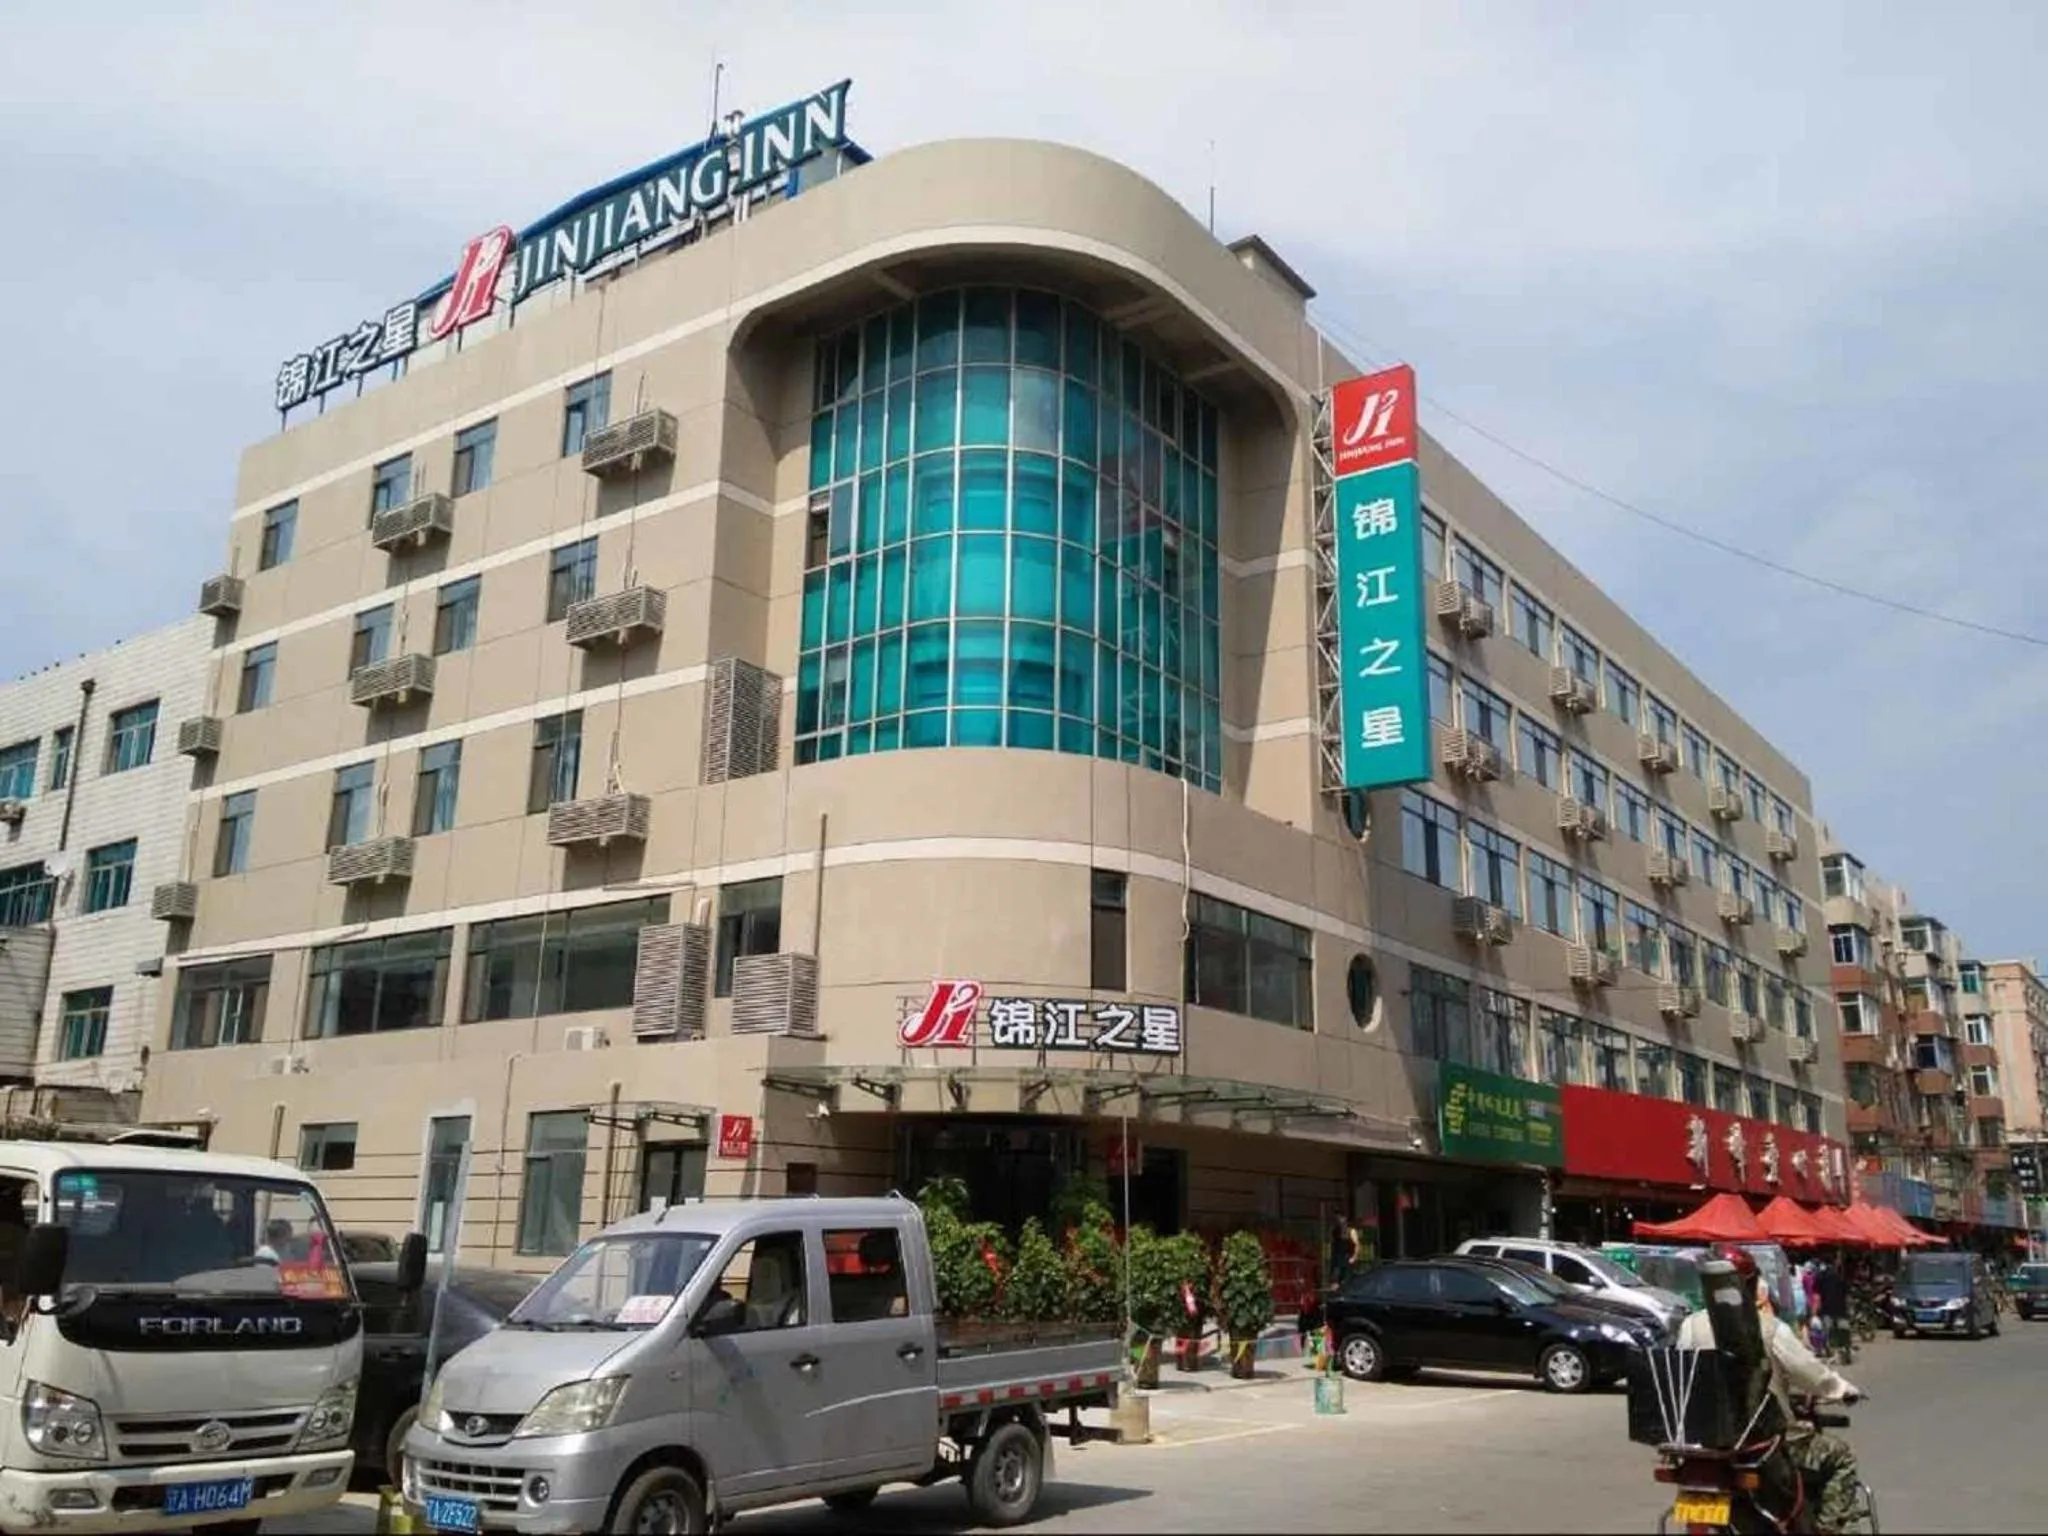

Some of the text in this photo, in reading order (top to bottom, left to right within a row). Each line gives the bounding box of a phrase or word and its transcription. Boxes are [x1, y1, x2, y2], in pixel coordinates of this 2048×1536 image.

[516, 89, 840, 296] JINJIANG INN
[278, 302, 416, 409] 锦江之星
[1352, 497, 1405, 750] 锦江之星
[989, 999, 1181, 1052] 锦江之星
[139, 1317, 302, 1336] FORLAND
